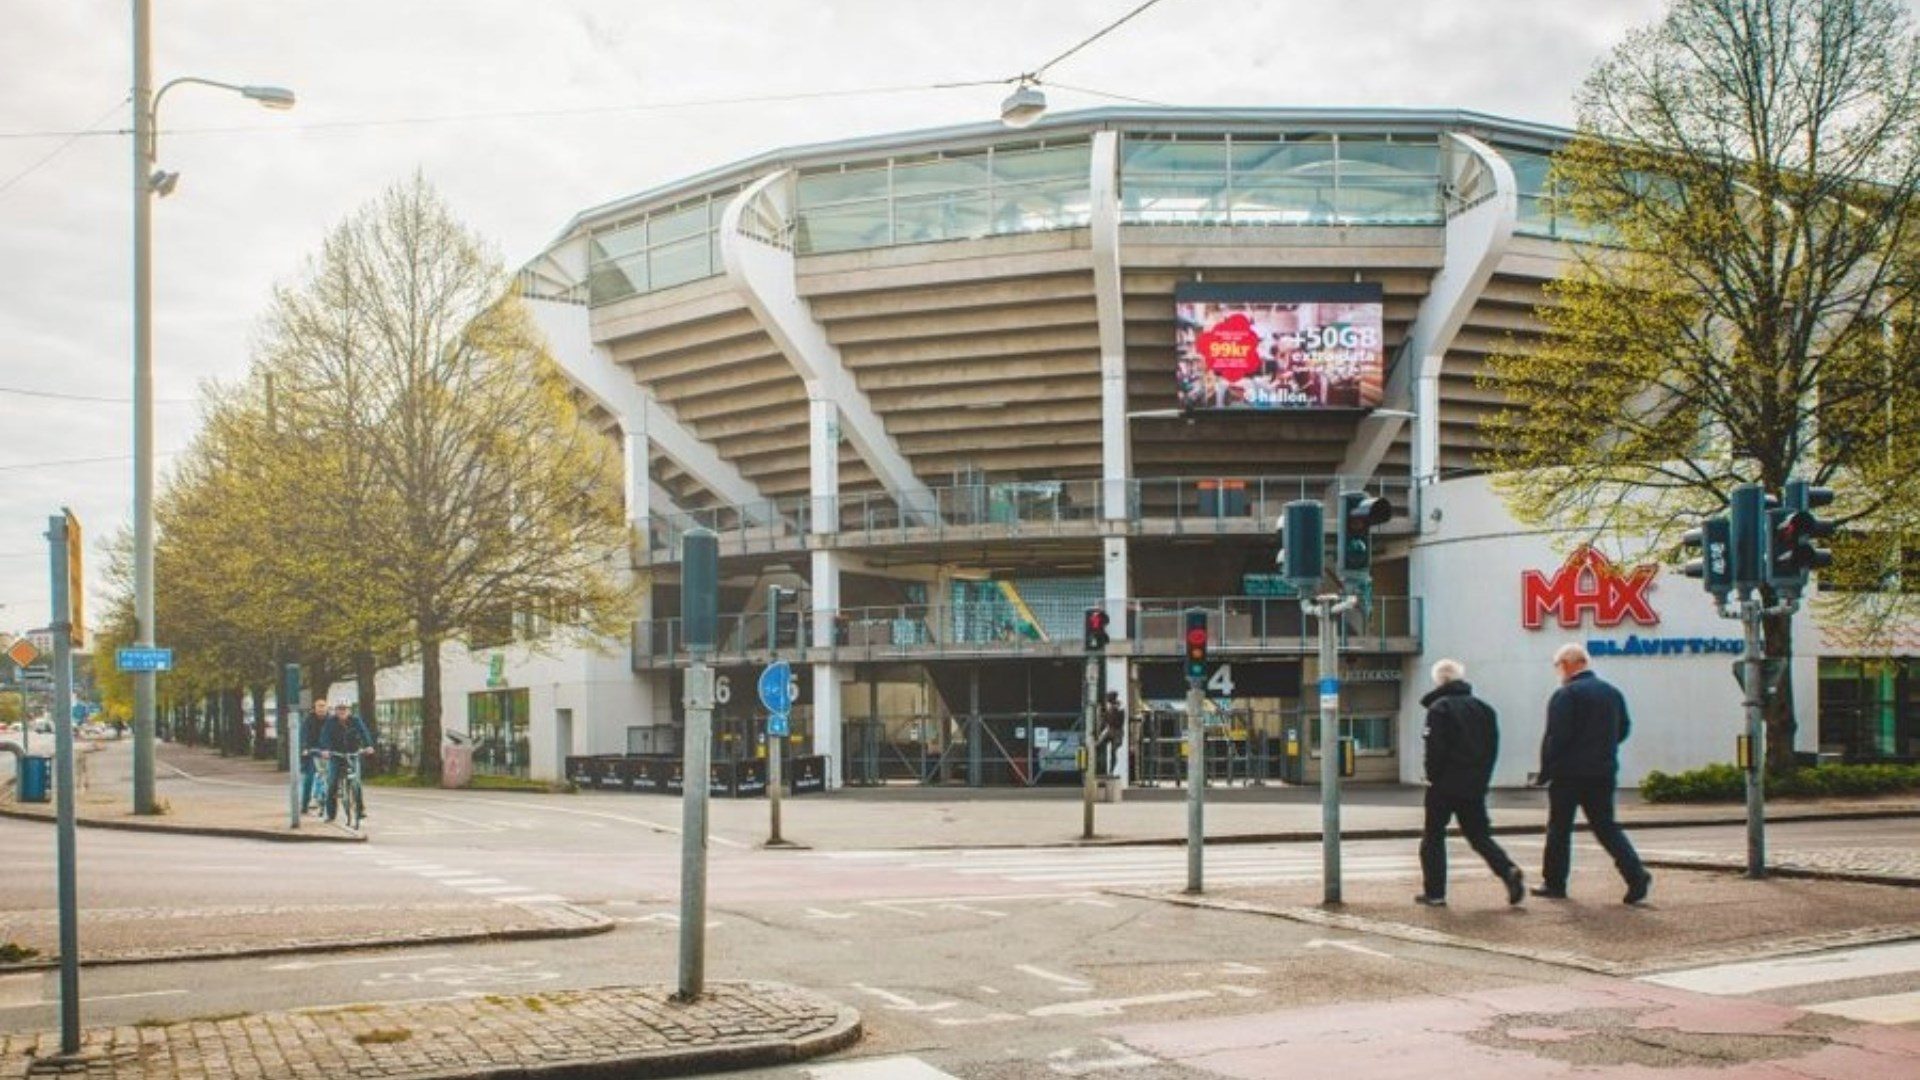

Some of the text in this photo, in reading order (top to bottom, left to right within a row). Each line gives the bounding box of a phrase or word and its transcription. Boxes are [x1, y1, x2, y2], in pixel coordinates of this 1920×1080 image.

[1210, 340, 1250, 358] 99kr
[1293, 326, 1377, 350] +50GB
[1523, 543, 1660, 628] MAX
[1208, 662, 1236, 695] 4
